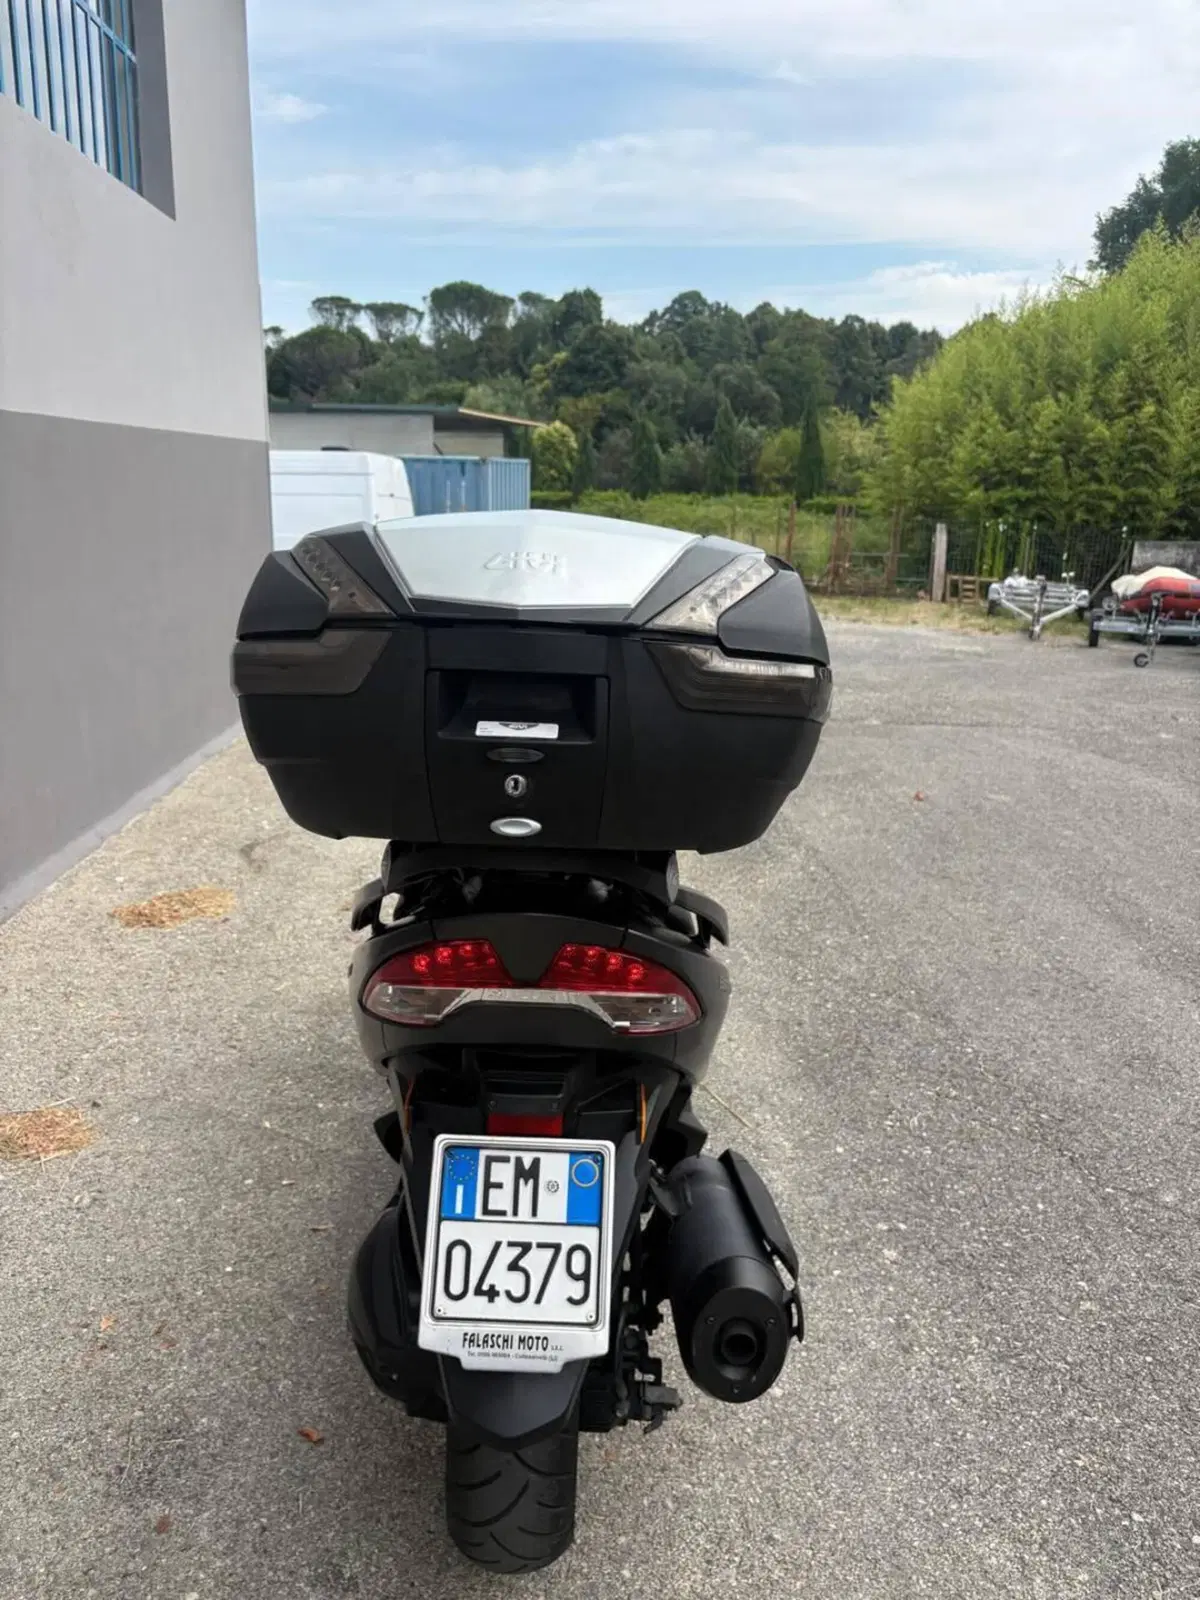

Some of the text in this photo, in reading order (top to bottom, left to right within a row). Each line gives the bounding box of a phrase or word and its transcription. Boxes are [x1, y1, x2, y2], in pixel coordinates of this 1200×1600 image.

[481, 1154, 542, 1218] EM
[443, 1238, 593, 1306] 04379
[462, 1332, 514, 1350] FALASCHI
[517, 1335, 550, 1351] MOTO
